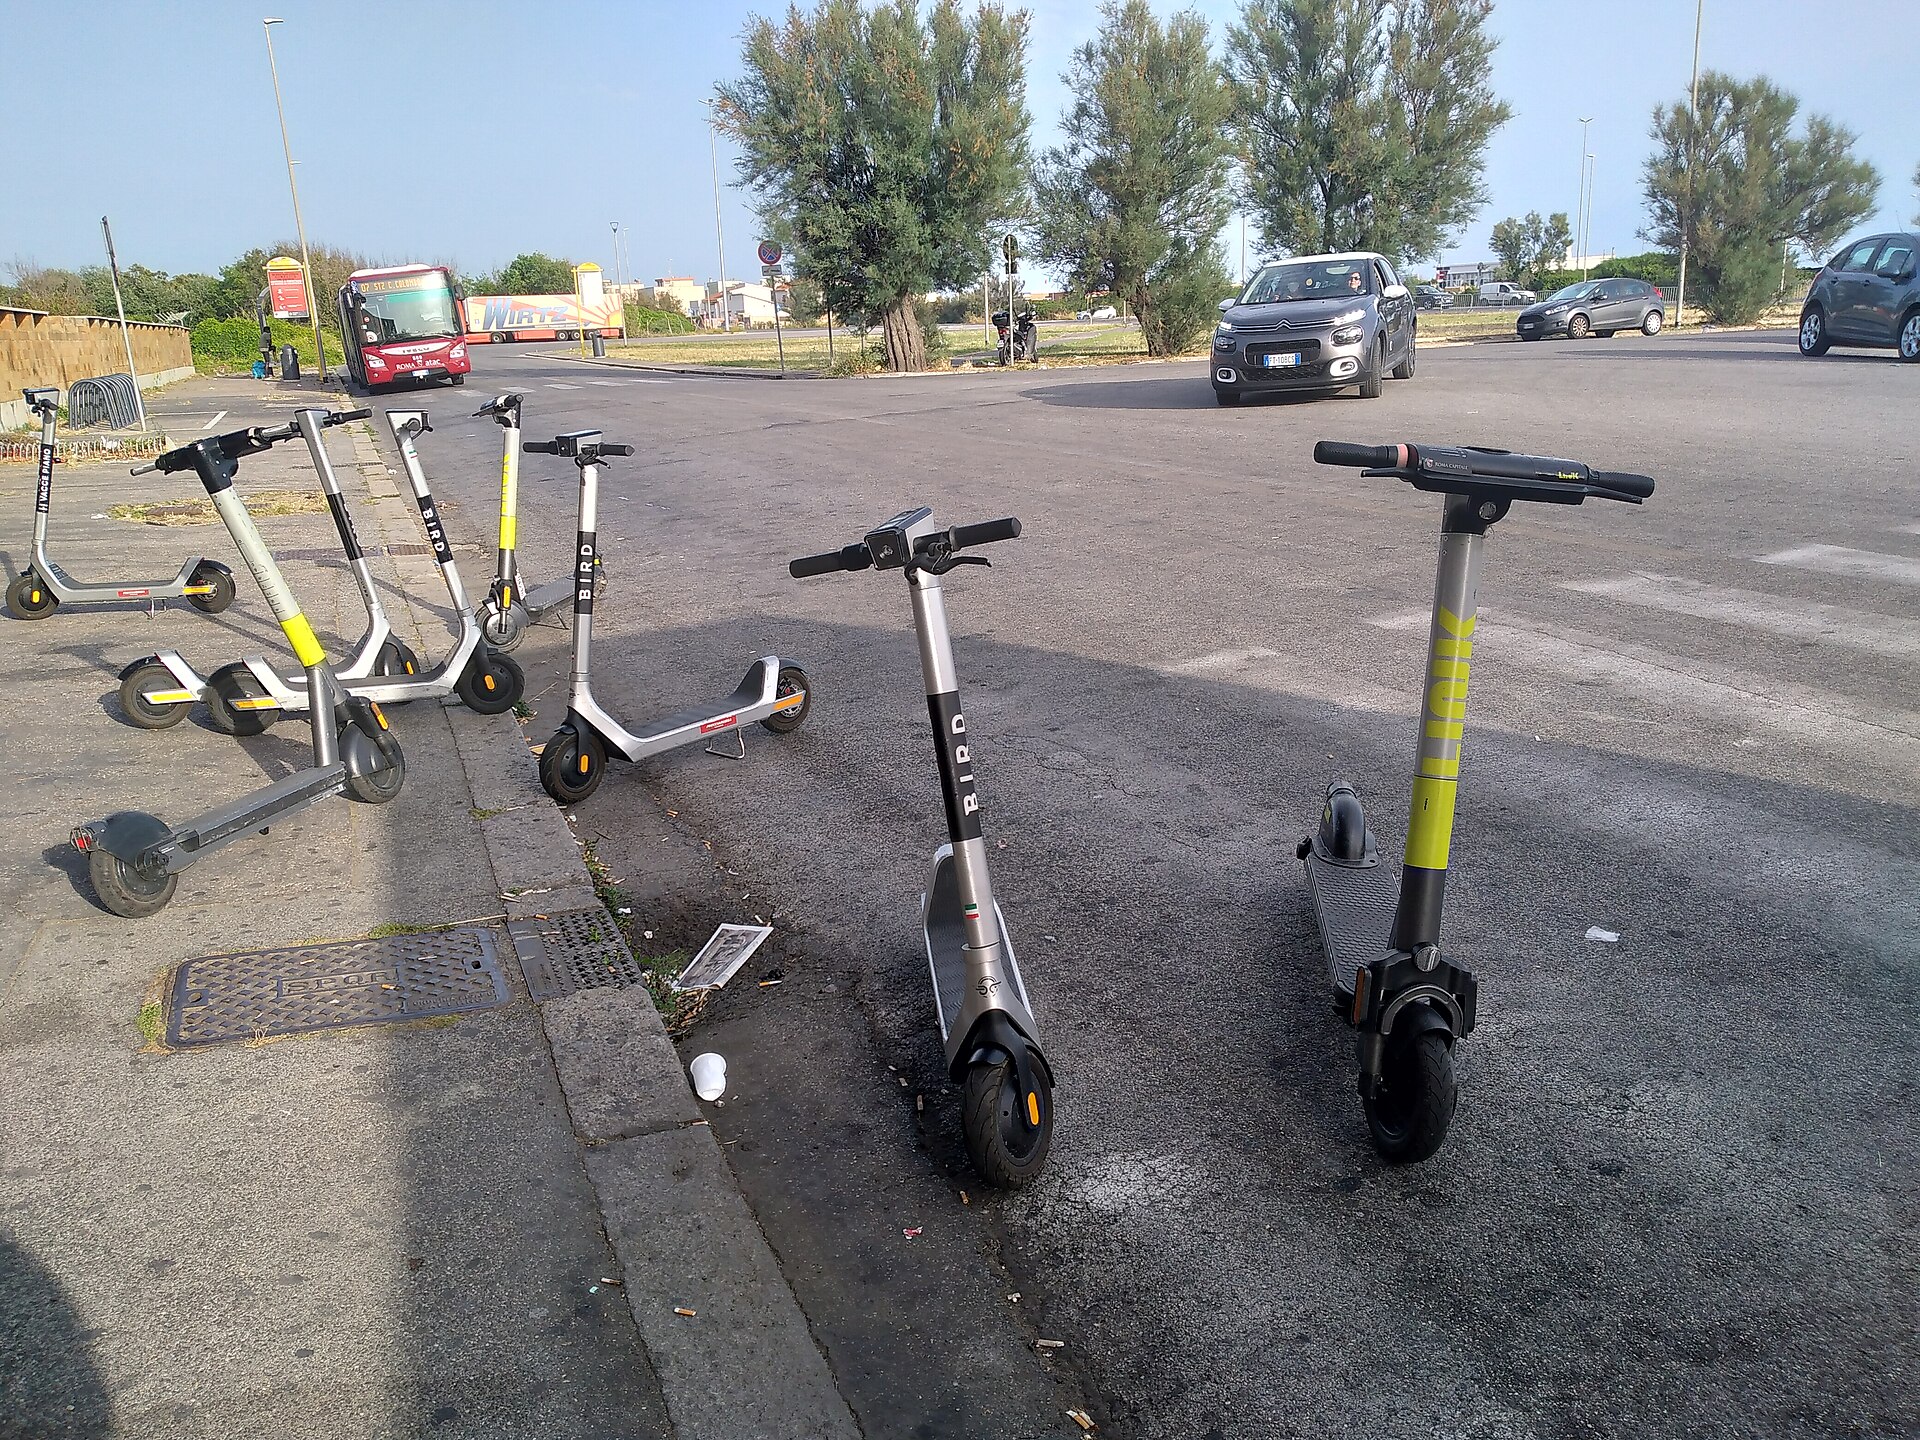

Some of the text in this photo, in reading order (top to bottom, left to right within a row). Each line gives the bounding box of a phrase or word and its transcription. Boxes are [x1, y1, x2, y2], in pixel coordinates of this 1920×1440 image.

[482, 297, 568, 330] WIRTZ
[396, 362, 416, 370] ROMA
[42, 448, 51, 474] PIANO
[422, 507, 445, 552] BIRD
[579, 544, 593, 601] BIRD
[951, 713, 979, 816] BIRD
